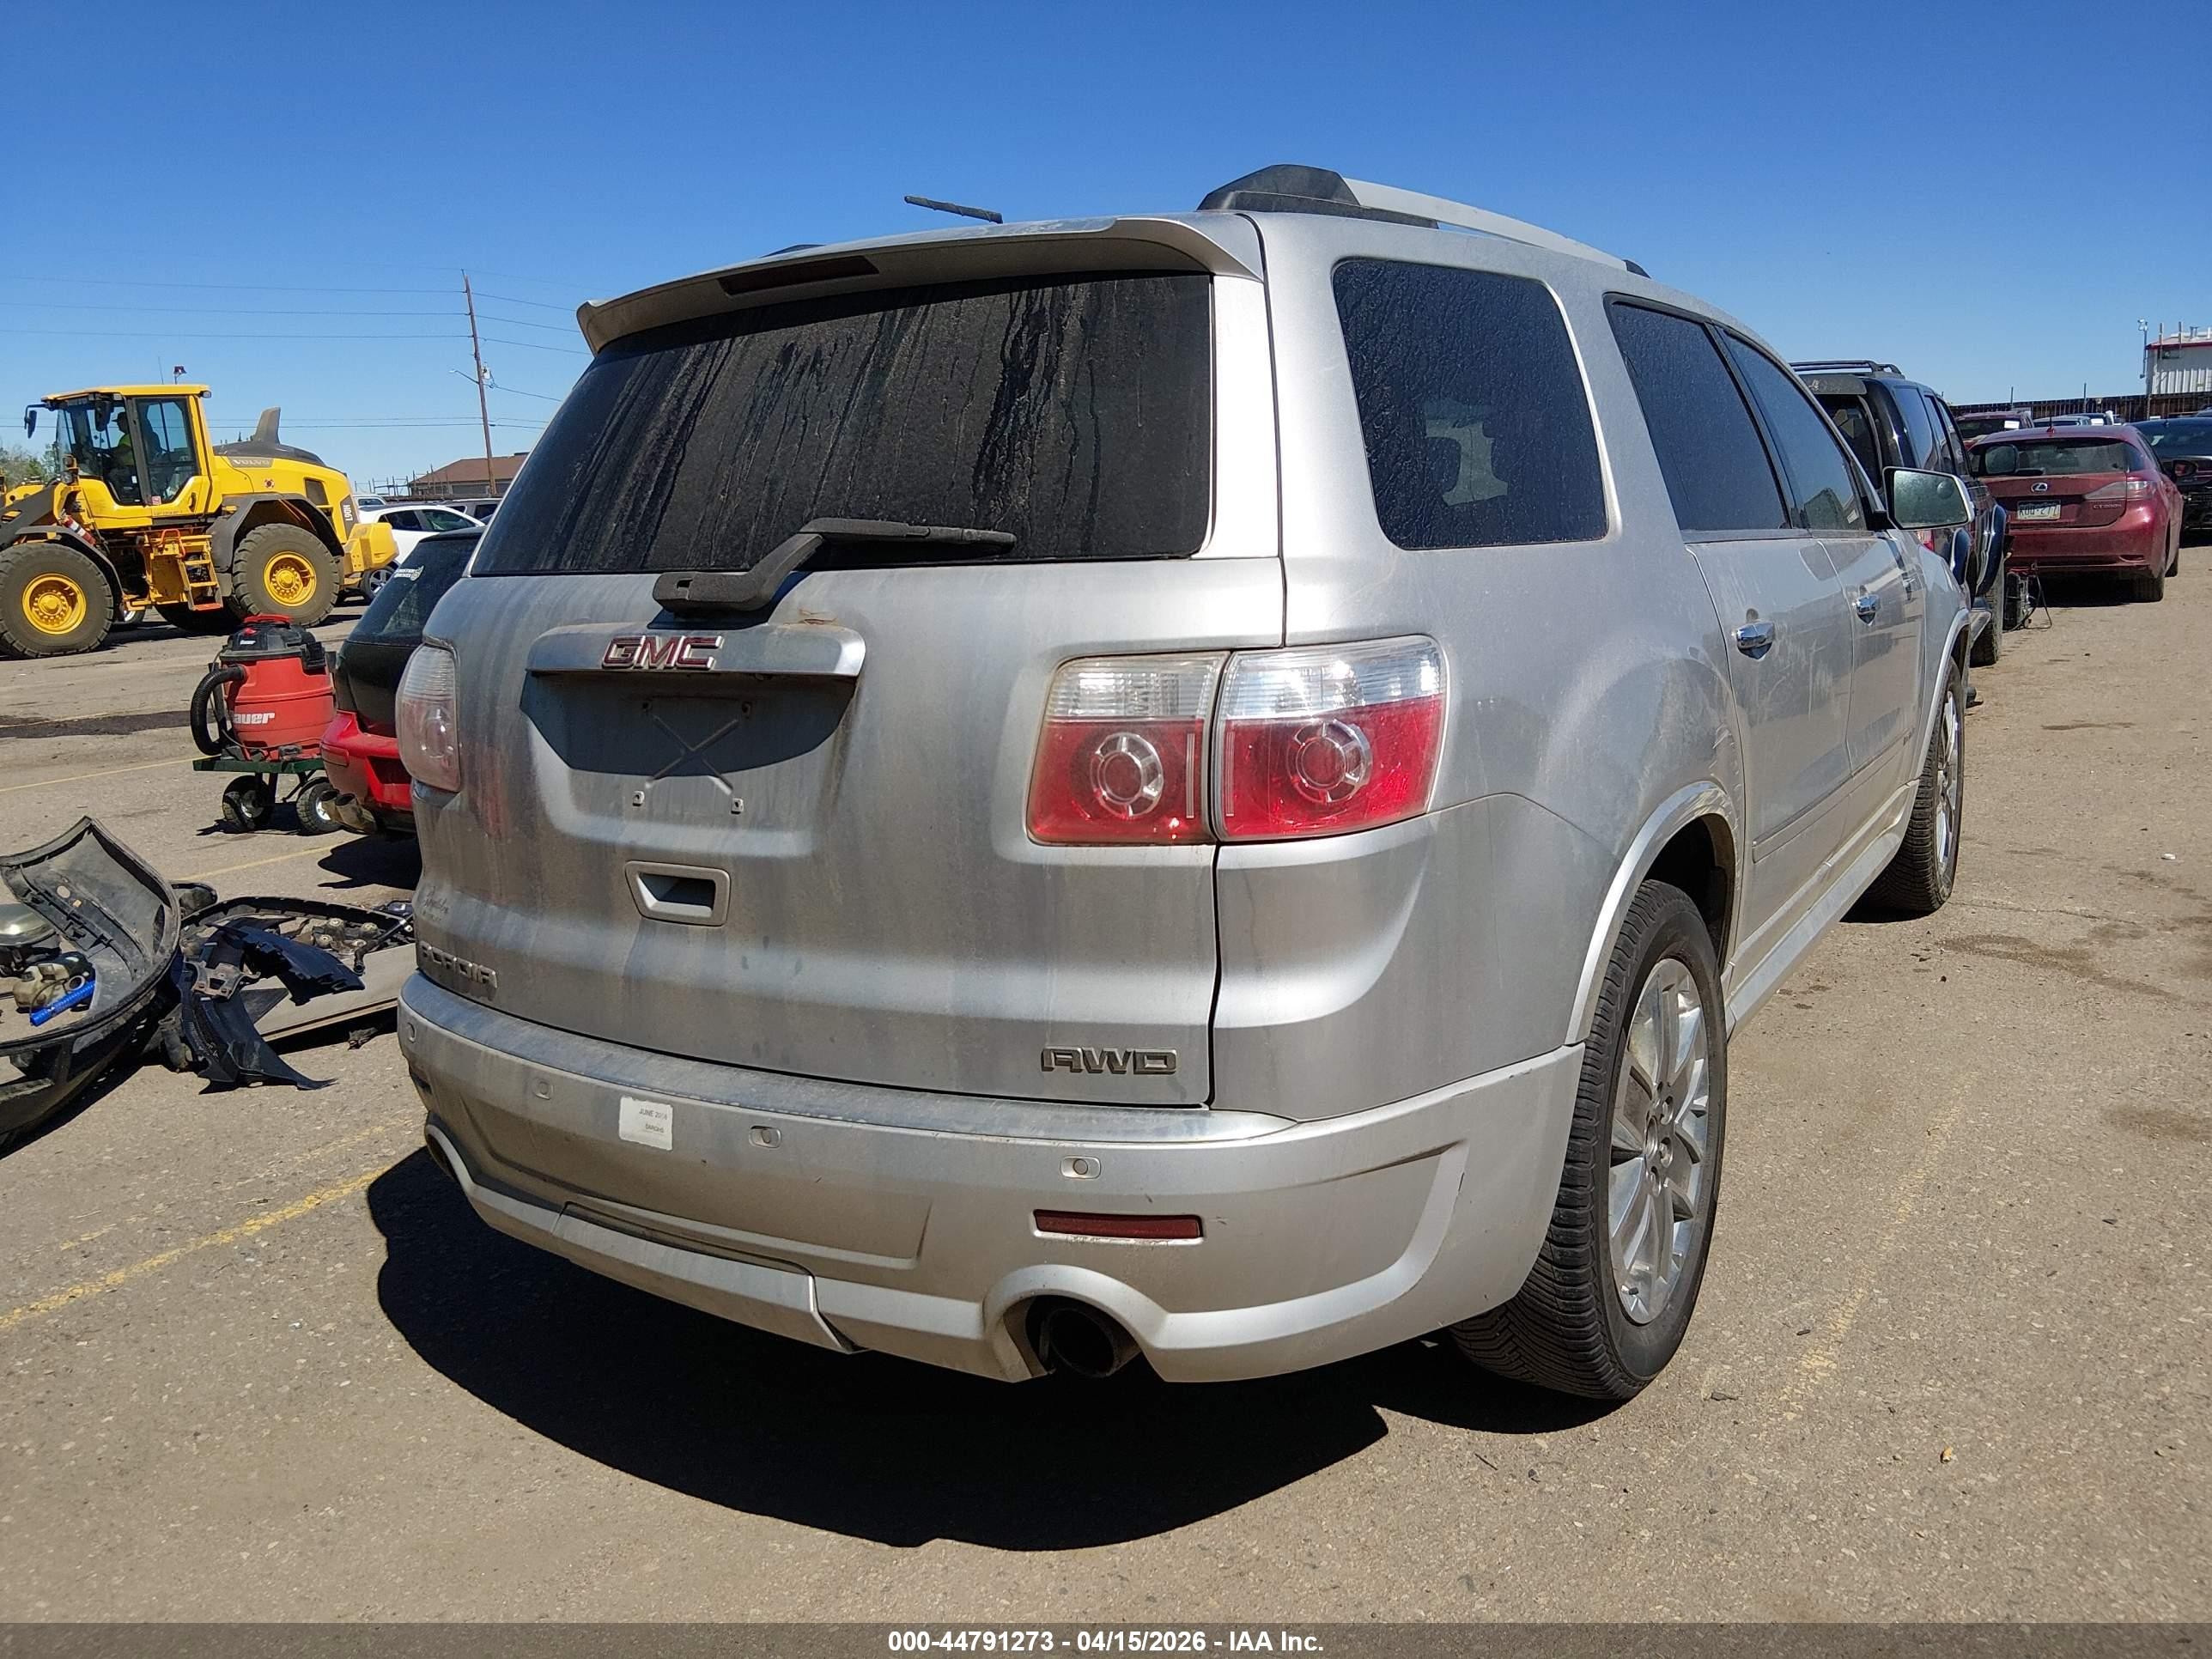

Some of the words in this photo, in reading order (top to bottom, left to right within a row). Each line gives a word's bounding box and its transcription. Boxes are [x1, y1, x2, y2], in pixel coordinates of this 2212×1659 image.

[601, 634, 725, 671] GMC
[233, 713, 275, 725] auer
[1041, 1046, 1177, 1074] AWD
